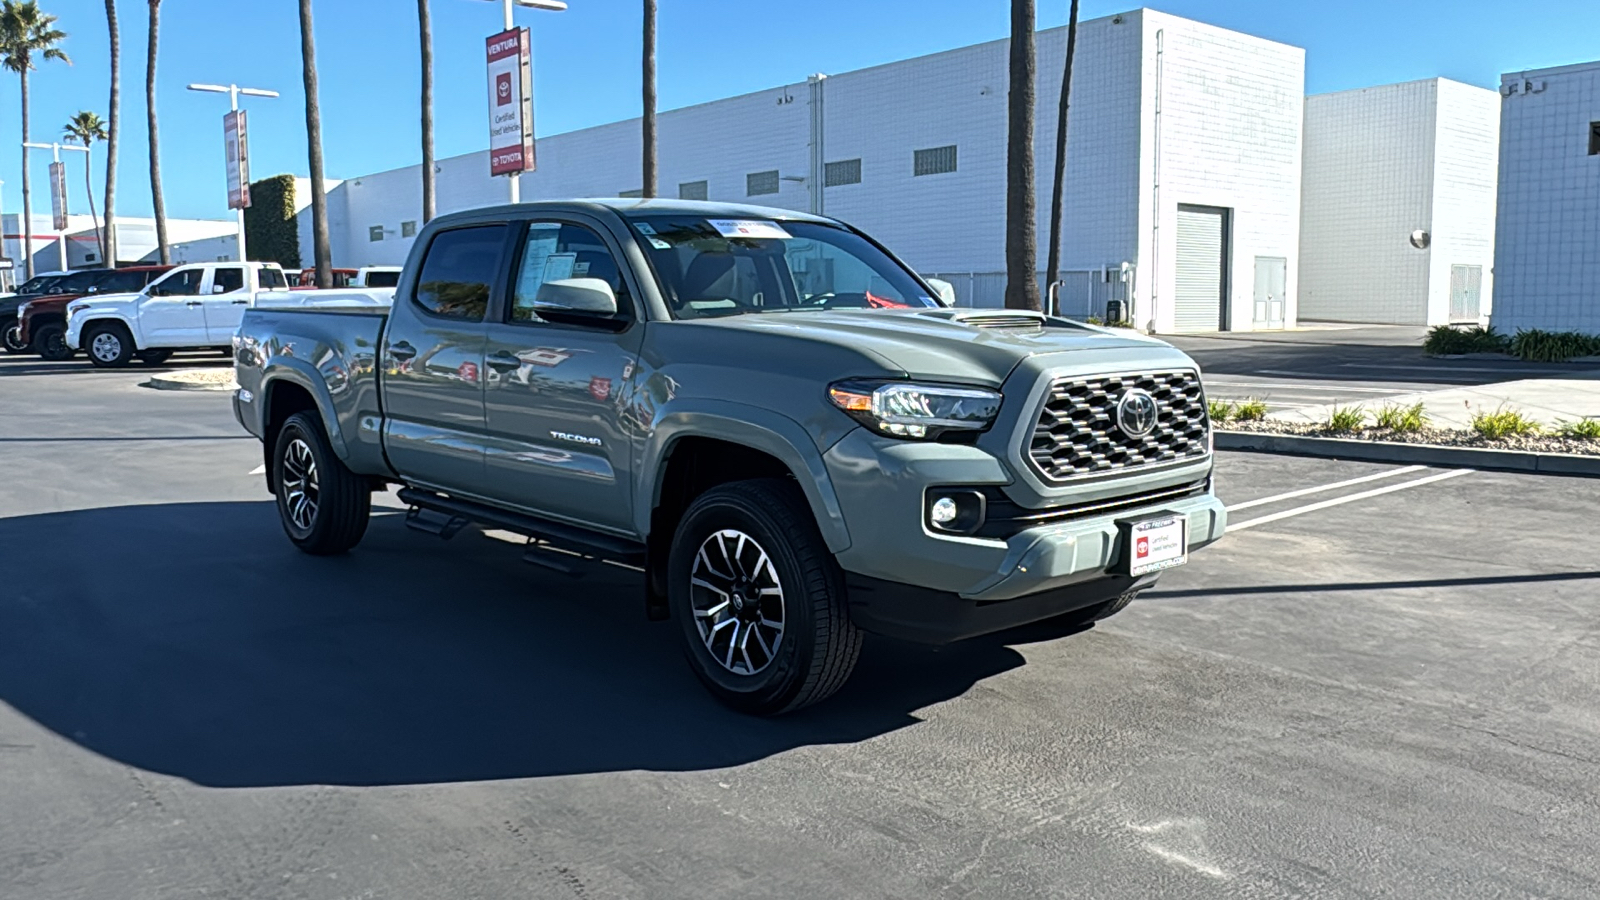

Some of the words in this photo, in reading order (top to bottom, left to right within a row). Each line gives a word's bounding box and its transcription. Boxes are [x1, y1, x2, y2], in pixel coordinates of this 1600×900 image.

[487, 37, 518, 55] VENTURA
[495, 111, 515, 124] Certified
[499, 152, 522, 165] TOYOTA
[550, 430, 602, 446] TACOMA
